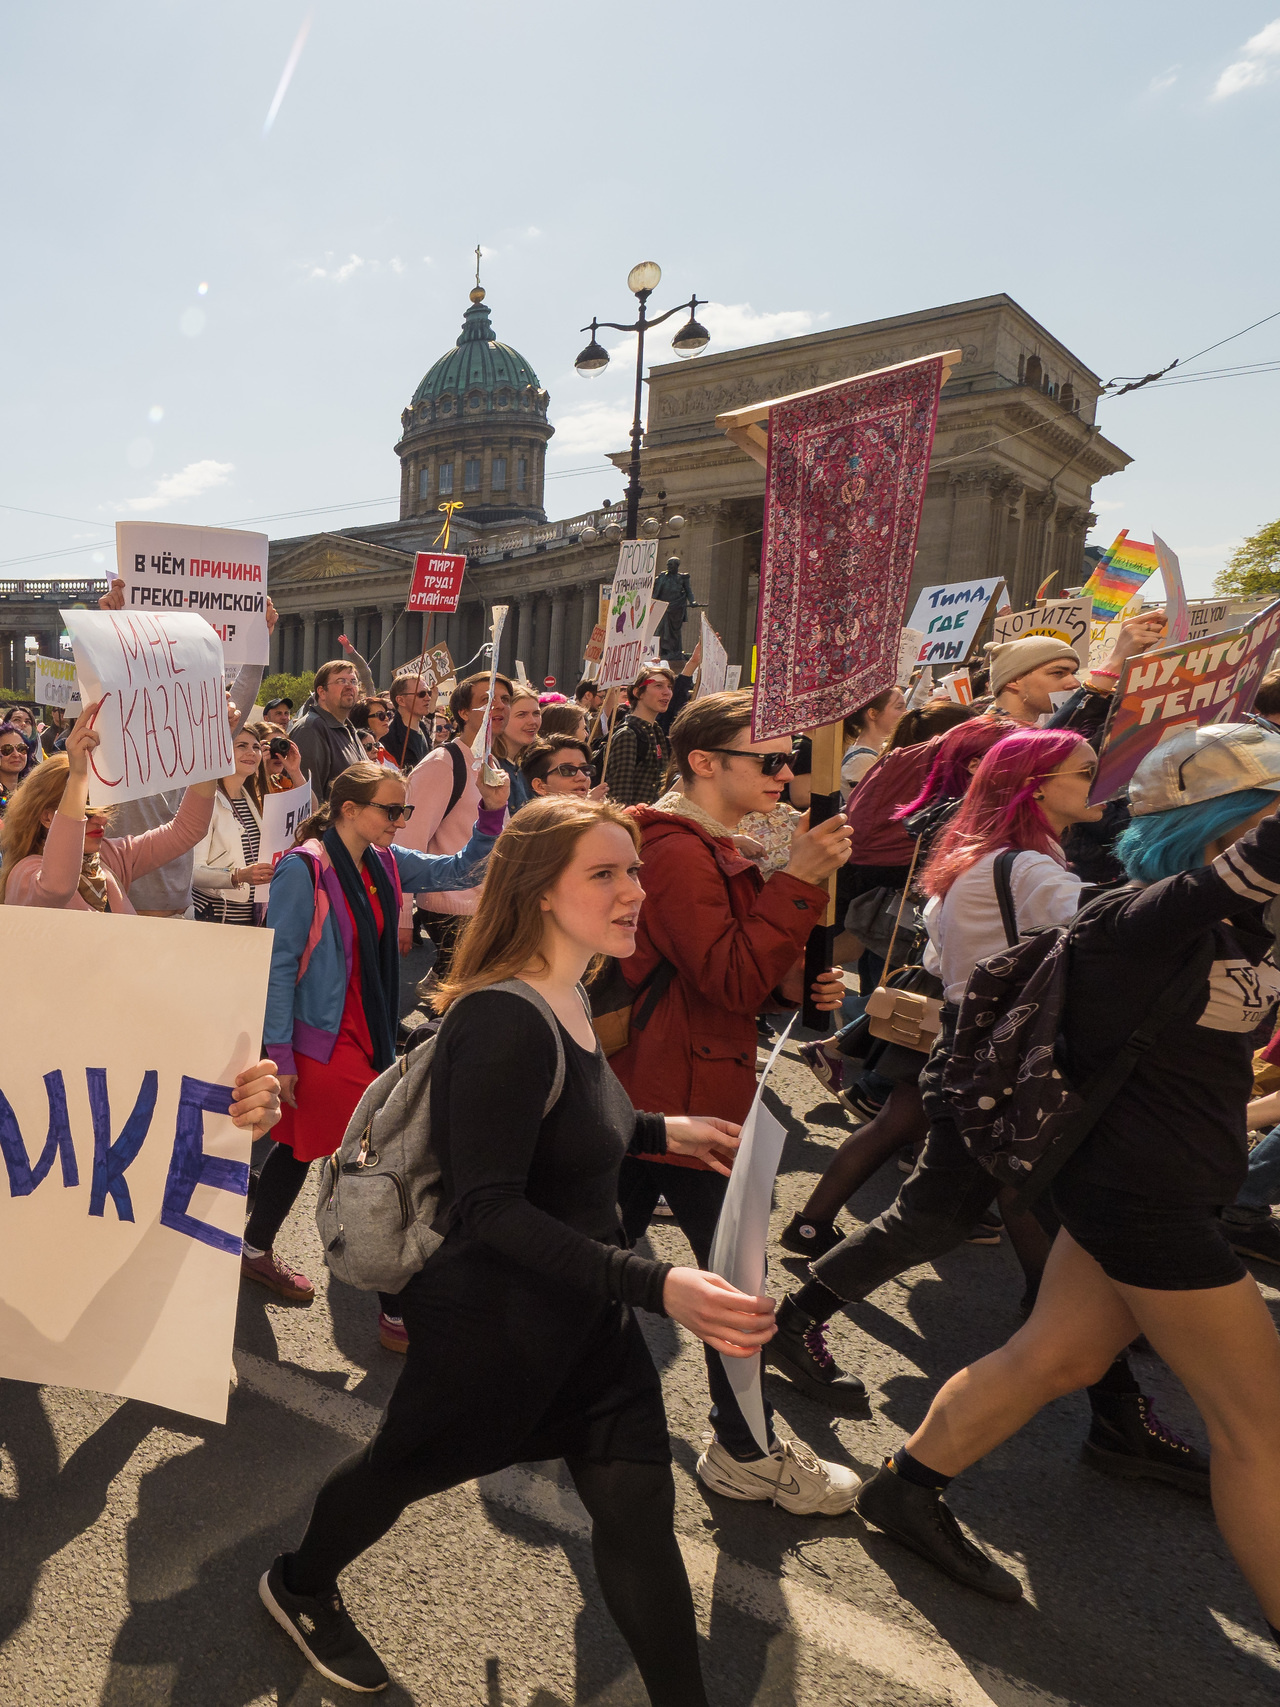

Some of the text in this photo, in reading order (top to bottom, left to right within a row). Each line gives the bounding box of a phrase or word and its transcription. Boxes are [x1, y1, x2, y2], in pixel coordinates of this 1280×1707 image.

[134, 552, 262, 583] В ЧЁМ ПРИЧИНА
[428, 559, 455, 573] МИР!
[423, 575, 455, 590] ТРУД!
[131, 586, 264, 613] ГРЕКО-РИМСКОЙ
[416, 589, 440, 606] МАЙ
[927, 609, 970, 635] ГДЕ
[995, 606, 1083, 645] ХОТИТЕ
[1190, 606, 1227, 627] TELL YOU
[109, 614, 186, 687] МНЕ
[915, 640, 964, 662] ЕМЫ
[1125, 654, 1185, 695] НУ,
